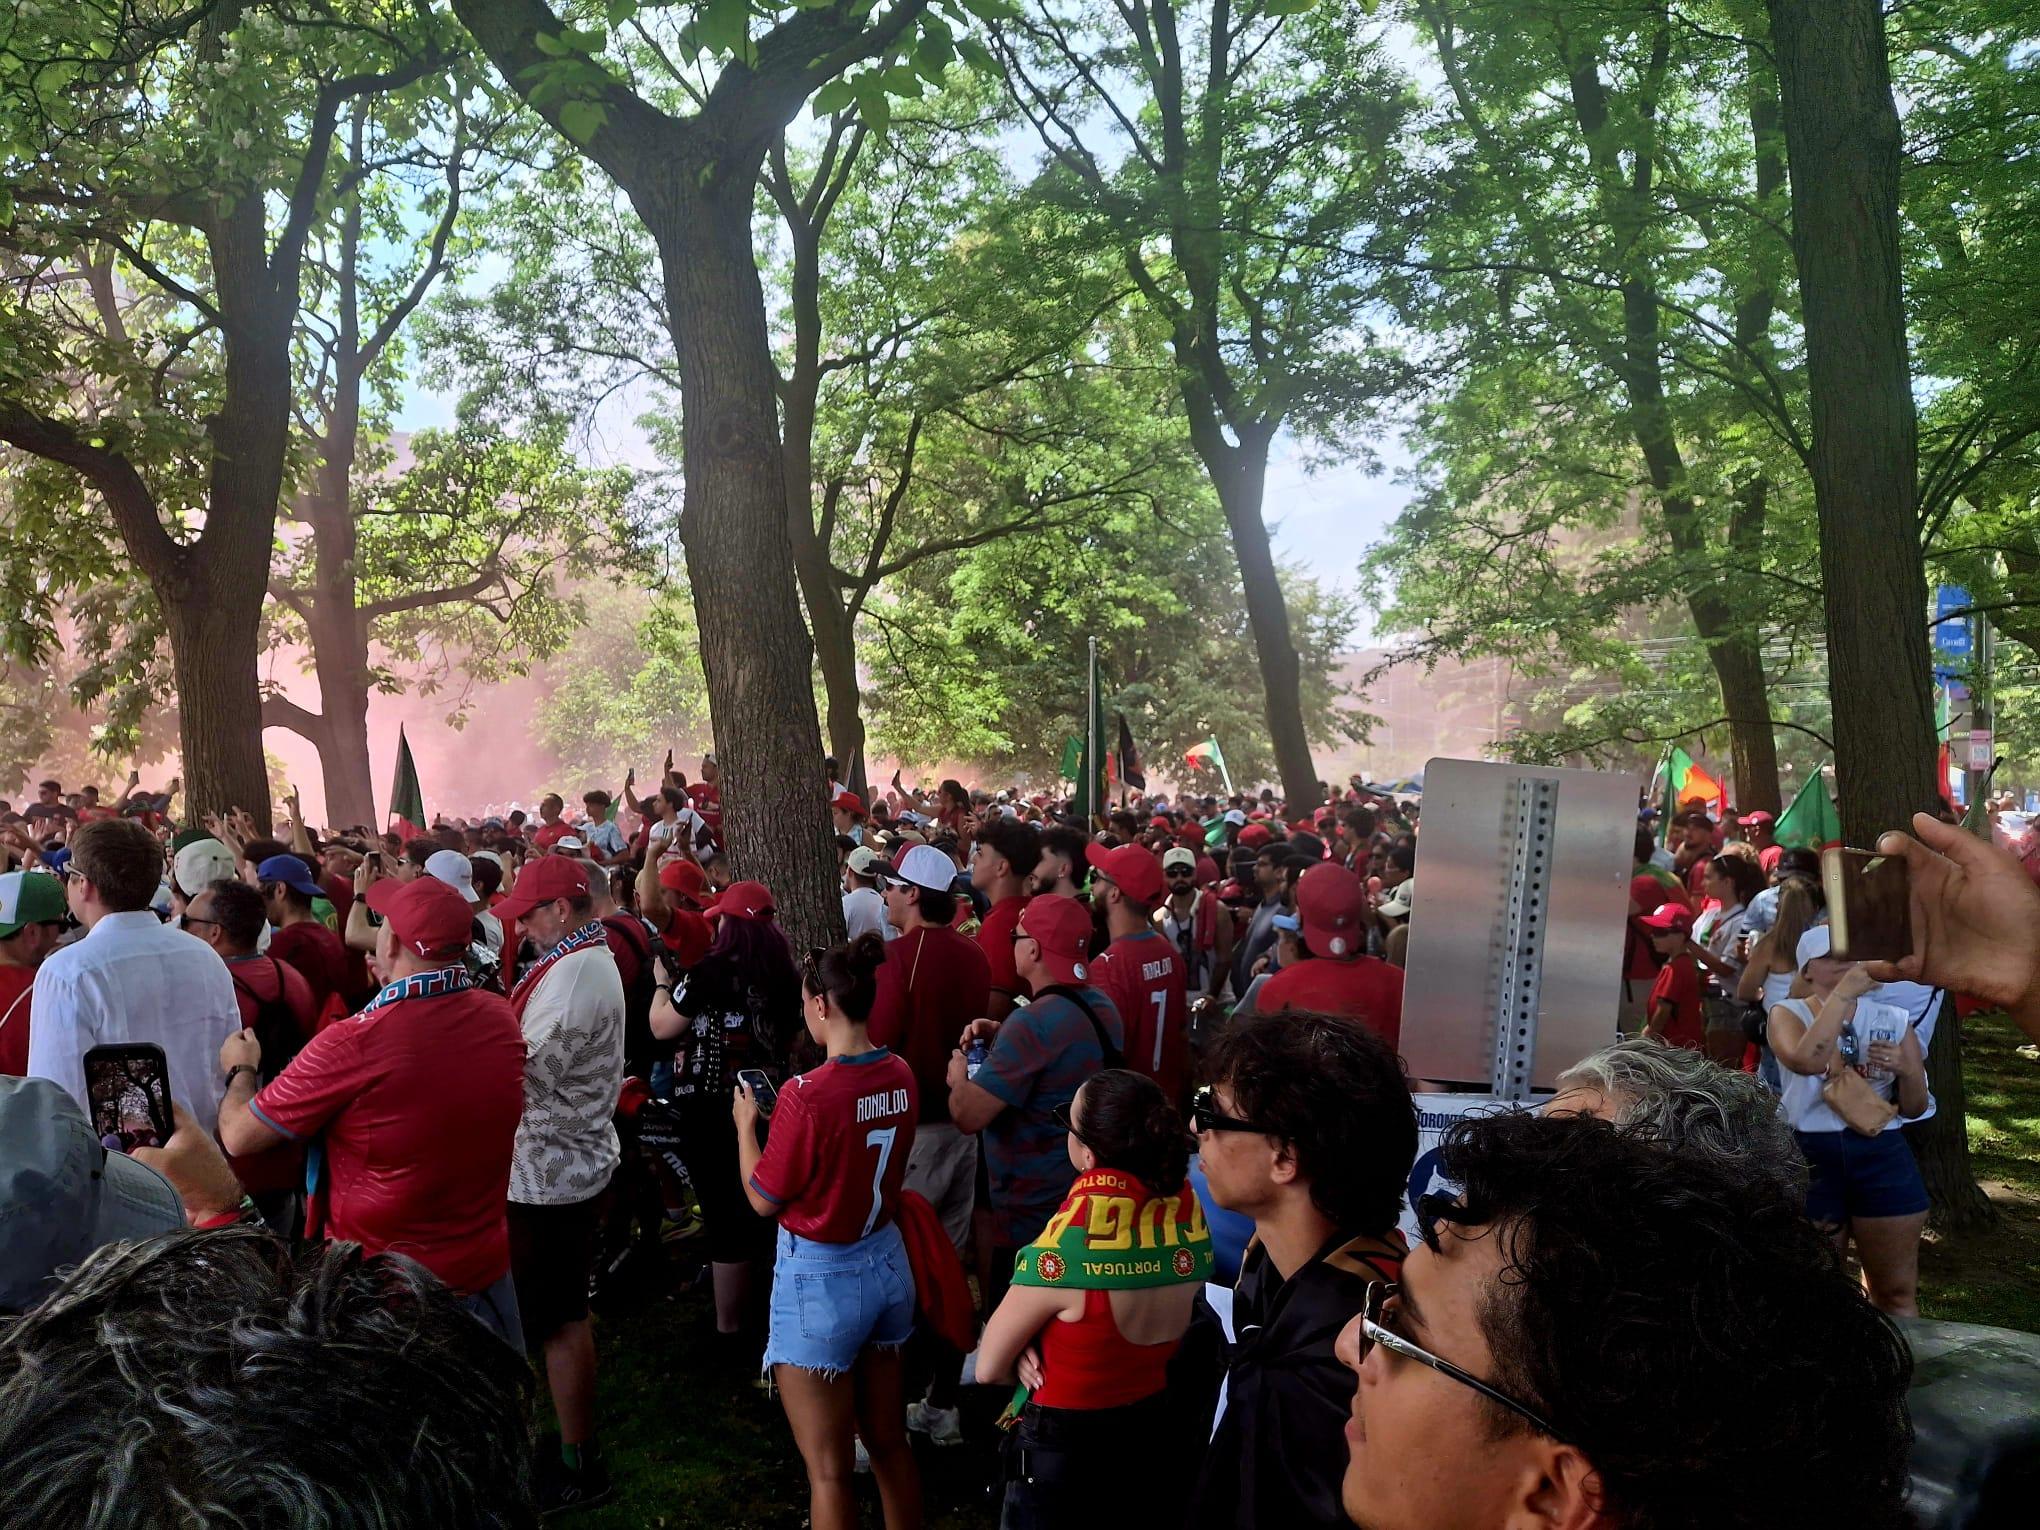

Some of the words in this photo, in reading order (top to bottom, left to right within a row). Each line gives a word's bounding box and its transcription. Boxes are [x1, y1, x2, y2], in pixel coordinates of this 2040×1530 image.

[1151, 989, 1167, 1072] 7
[857, 1088, 908, 1123] RONALDO
[861, 1126, 897, 1238] 7
[1082, 1260, 1161, 1276] PORTUGAL
